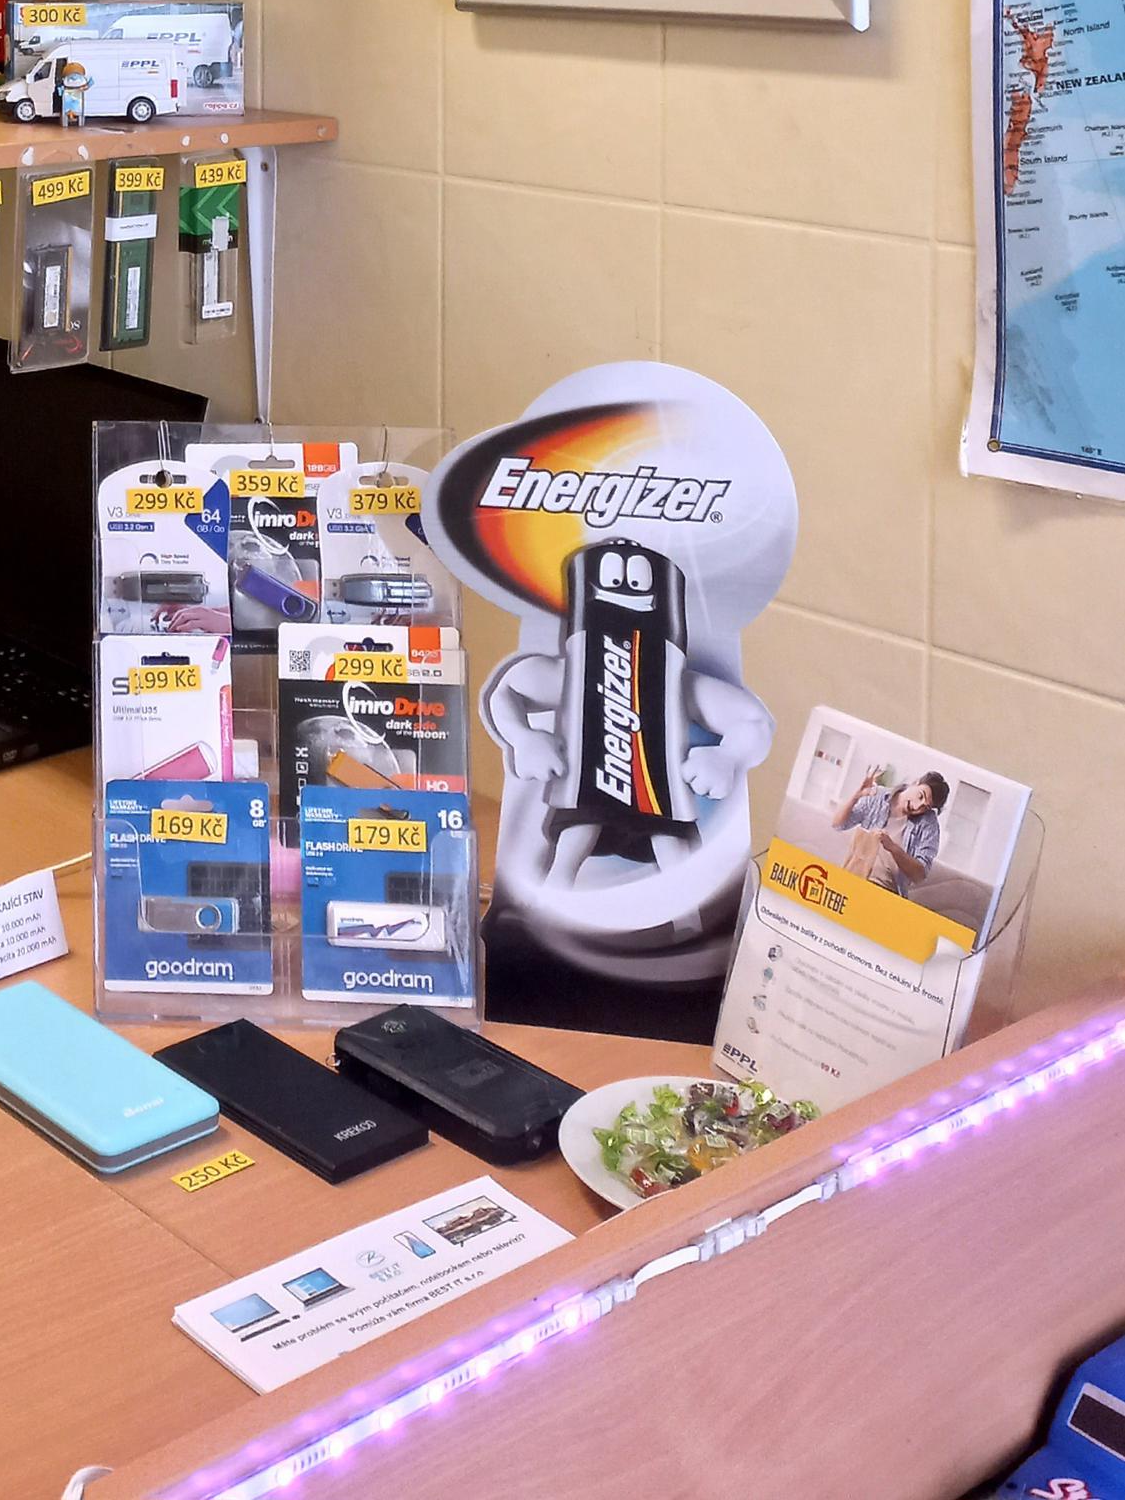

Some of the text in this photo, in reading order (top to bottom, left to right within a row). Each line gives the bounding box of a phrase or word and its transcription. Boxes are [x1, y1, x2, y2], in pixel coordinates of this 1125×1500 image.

[29, 7, 81, 23] 300 Kč
[1063, 21, 1110, 37] North Island
[128, 60, 160, 68] PPL
[1056, 77, 1082, 90] NEW
[1020, 154, 1068, 166] South Island
[118, 172, 161, 188] 399 Kč
[199, 165, 242, 184] 439 Kč
[37, 177, 84, 200] 499 Kč
[307, 464, 337, 473] 128GB
[236, 475, 299, 492] 359 Kč
[479, 455, 732, 528] Energizer
[134, 491, 196, 510] 299 Kč
[353, 491, 416, 511] 379 Kč
[107, 506, 124, 518] V3
[201, 508, 221, 524] 64
[326, 508, 343, 519] V3
[196, 525, 209, 533] GB
[214, 525, 225, 533] Go
[289, 531, 314, 541] dark
[338, 658, 403, 677] 299 Kč
[134, 669, 196, 689] 199 Kč
[349, 696, 445, 716] imroDrive
[385, 719, 437, 730] dark side
[595, 634, 641, 807] Energizer
[426, 780, 449, 791] HQ
[249, 798, 265, 818] 8
[157, 815, 223, 837] 169 Kč
[252, 819, 266, 828] GB
[438, 809, 463, 830] 16
[110, 834, 136, 843] FLASH
[354, 825, 421, 846] 179 Kč
[305, 841, 335, 852] FLASH
[23, 888, 44, 905] STAV
[770, 862, 849, 915] BALÍK TEBE
[1, 918, 24, 934] 10.000
[25, 913, 41, 925] mAh
[6, 931, 29, 947] 10.000
[29, 926, 46, 939] mAh
[17, 941, 40, 957] 20.000
[41, 935, 57, 948] mAh
[145, 958, 234, 980] goodram
[343, 970, 433, 992] goodram
[729, 1046, 758, 1073] PPL
[179, 1153, 247, 1188] 250 Kč
[298, 1322, 336, 1347] problém
[336, 1317, 347, 1327] se
[348, 1306, 372, 1323] svým
[419, 1259, 471, 1287] notebookem
[471, 1252, 491, 1265] nebo
[387, 1307, 405, 1321] vám
[406, 1294, 429, 1311] firma
[428, 1282, 454, 1301] BEST
[454, 1279, 464, 1290] IT
